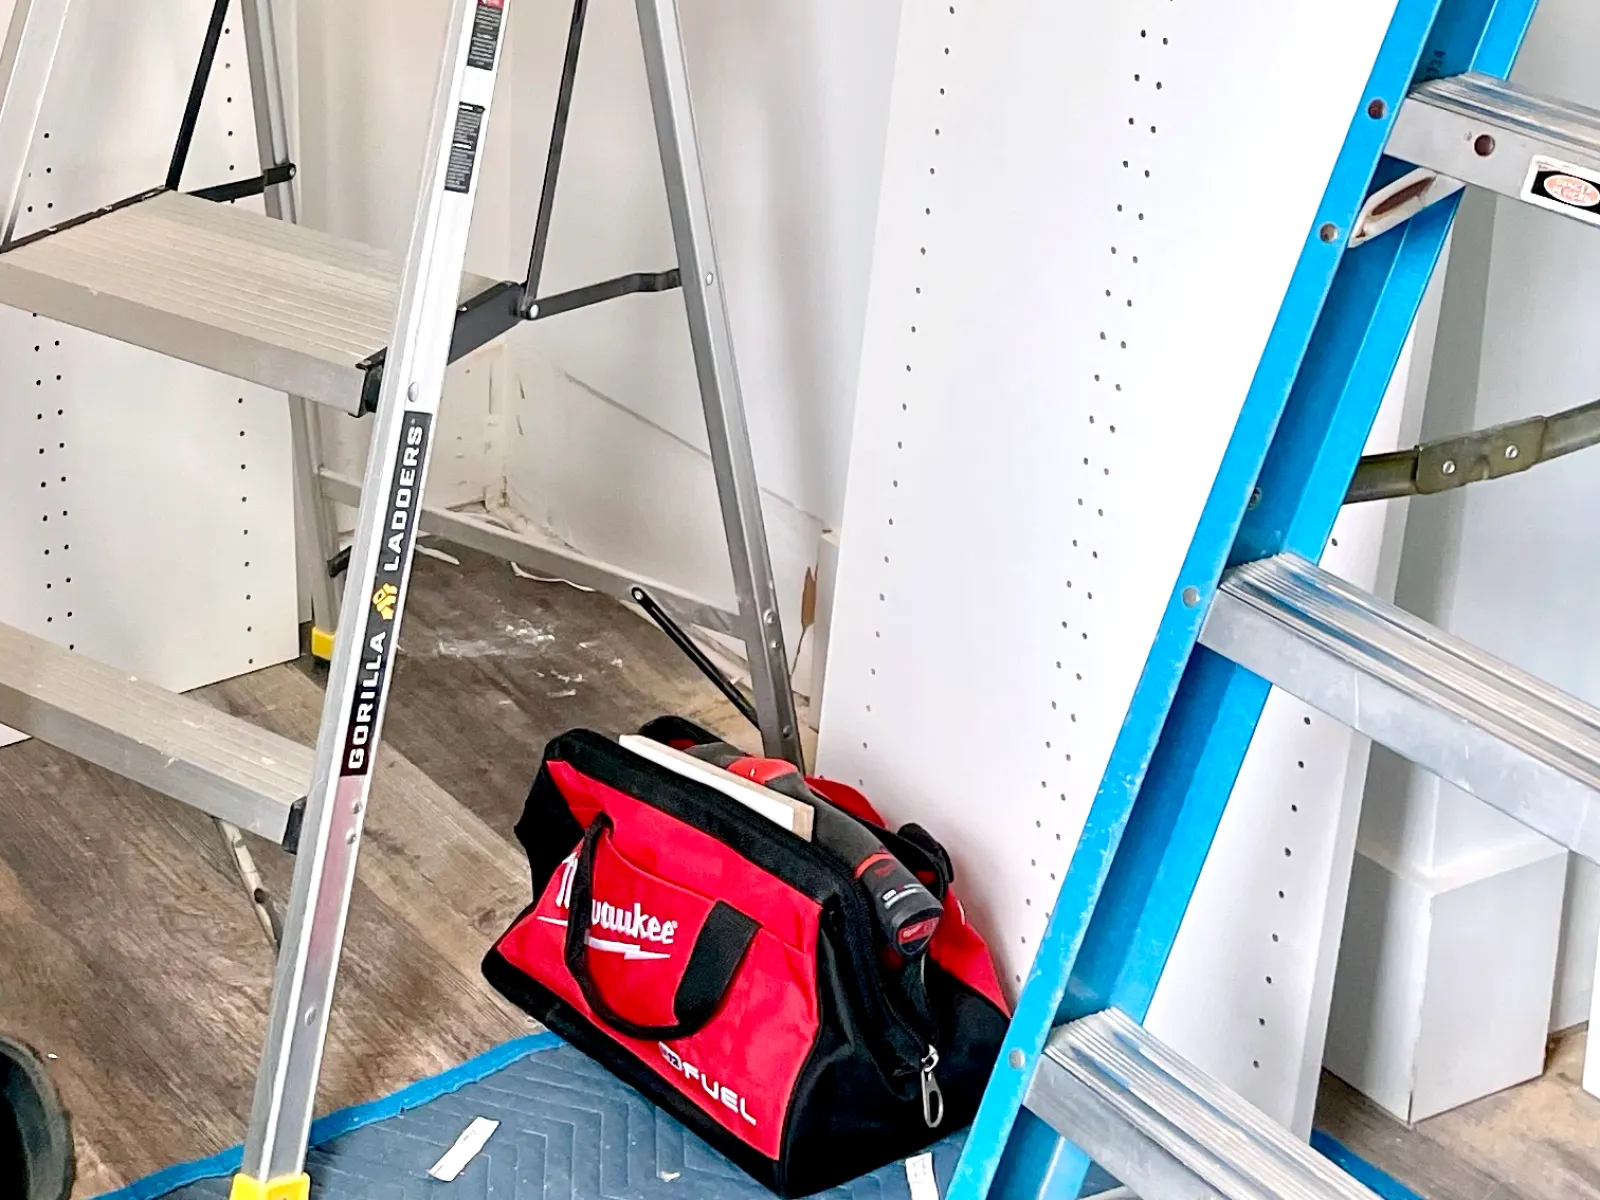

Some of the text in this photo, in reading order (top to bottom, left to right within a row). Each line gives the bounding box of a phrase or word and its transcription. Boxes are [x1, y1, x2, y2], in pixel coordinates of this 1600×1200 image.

[348, 426, 423, 769] GORILLA LADDERS
[555, 850, 675, 946] Mwaukee
[684, 1061, 757, 1127] FUEL
